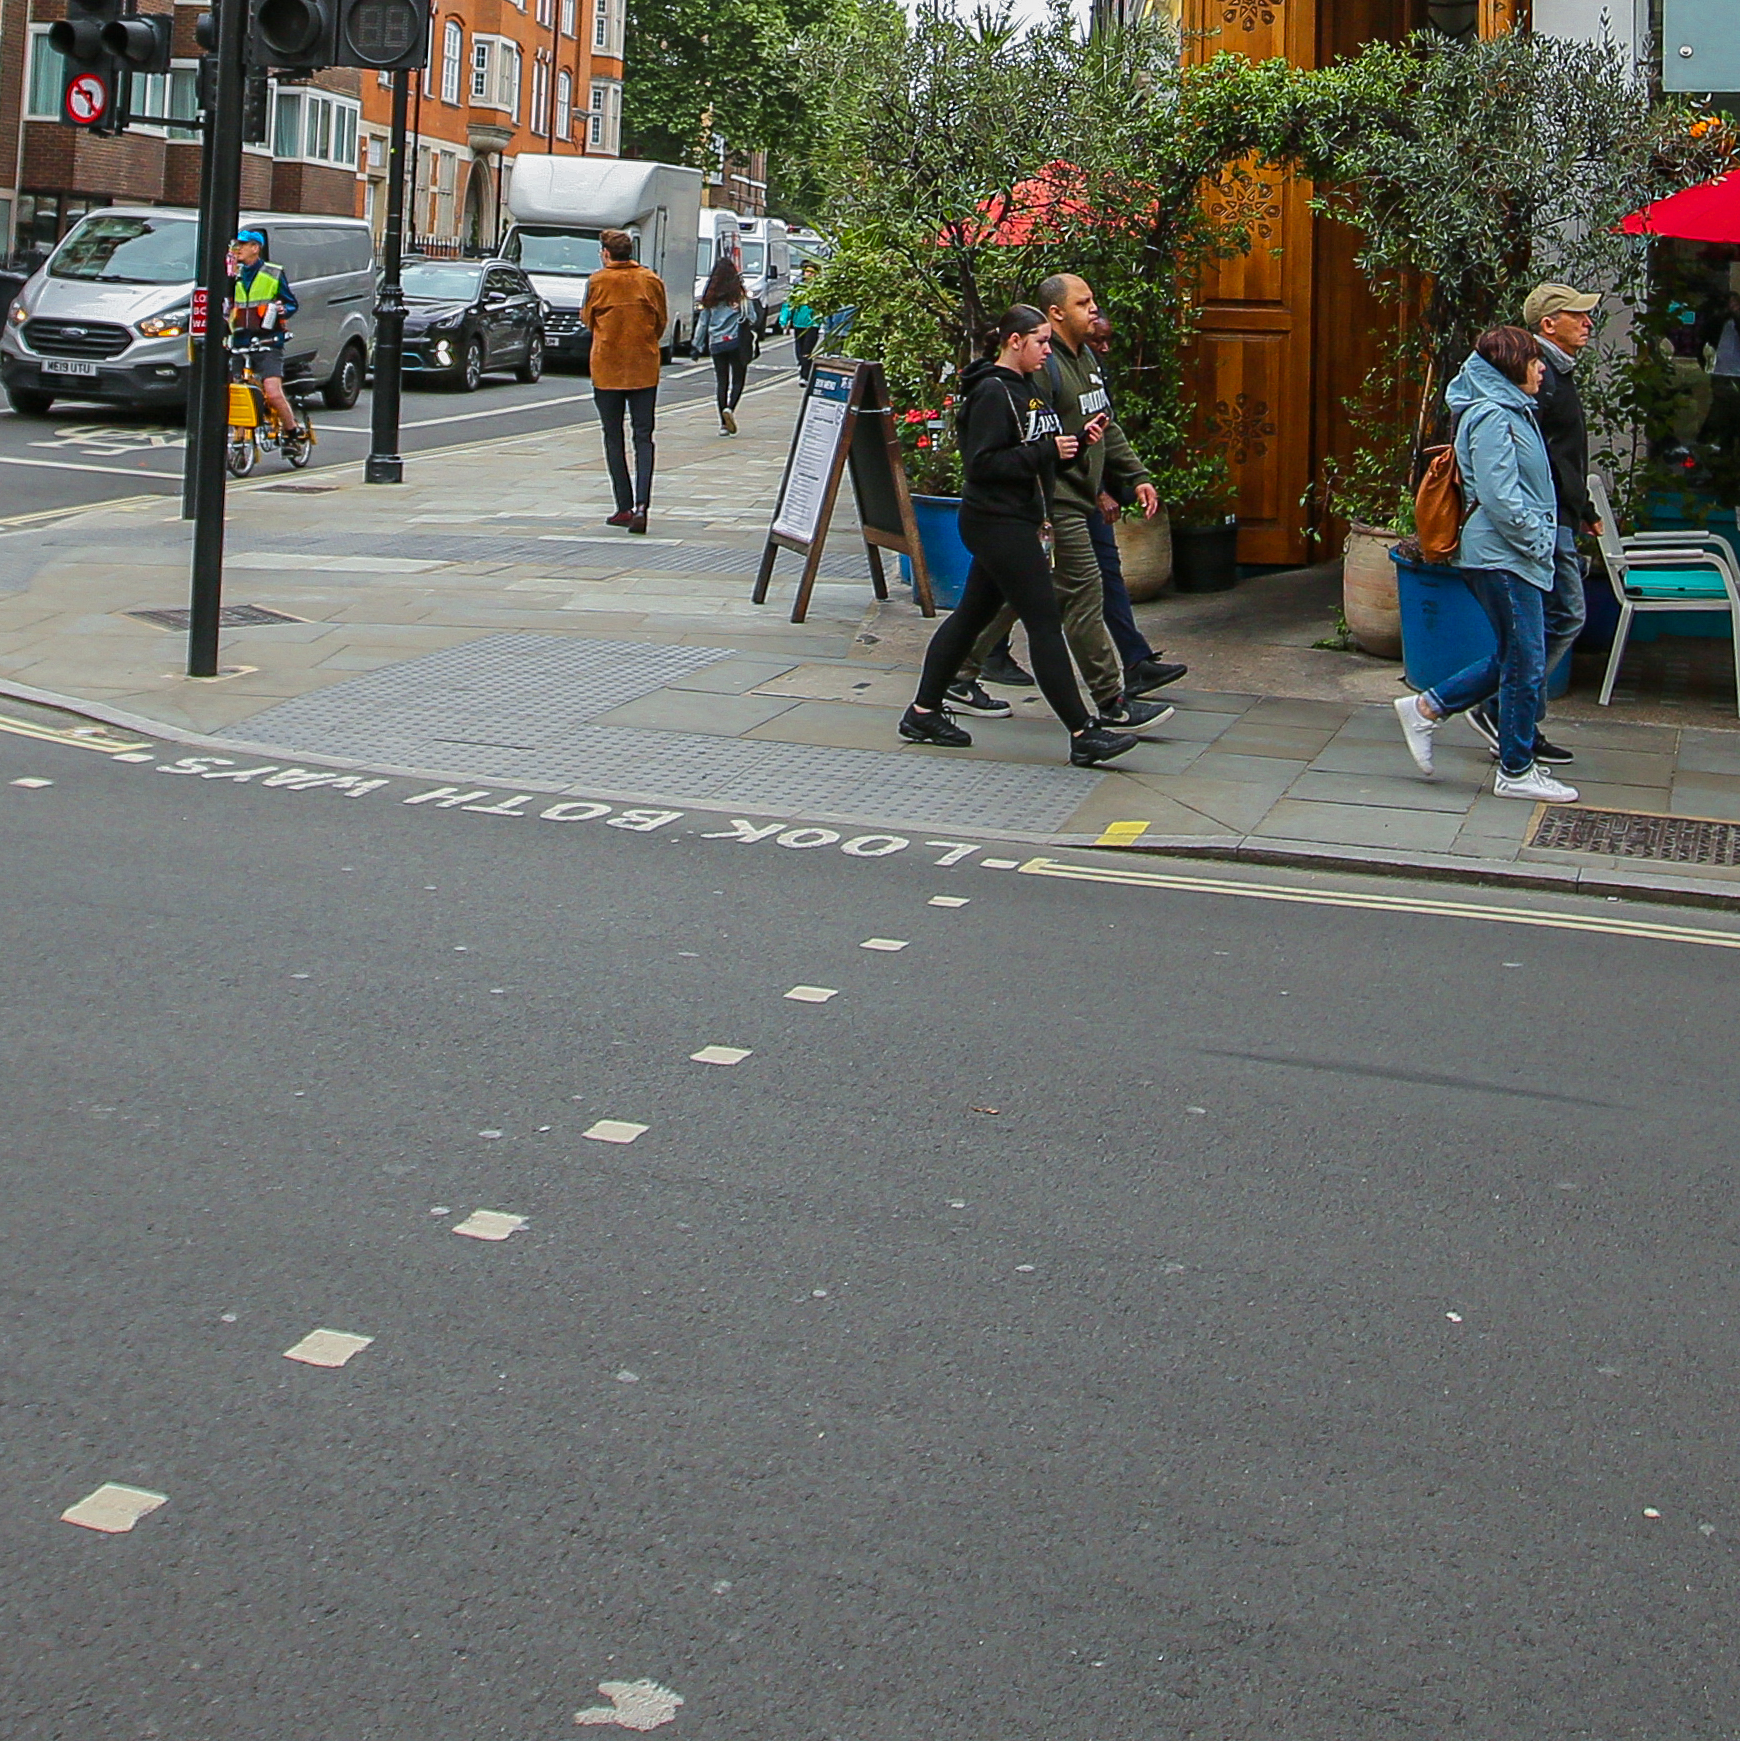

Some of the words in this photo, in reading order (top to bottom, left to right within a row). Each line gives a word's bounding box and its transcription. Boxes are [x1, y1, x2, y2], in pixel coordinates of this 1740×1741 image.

[193, 293, 207, 303] LO
[155, 757, 390, 798] WAYS
[403, 787, 685, 833] BOTH
[700, 819, 982, 867] LOOK
